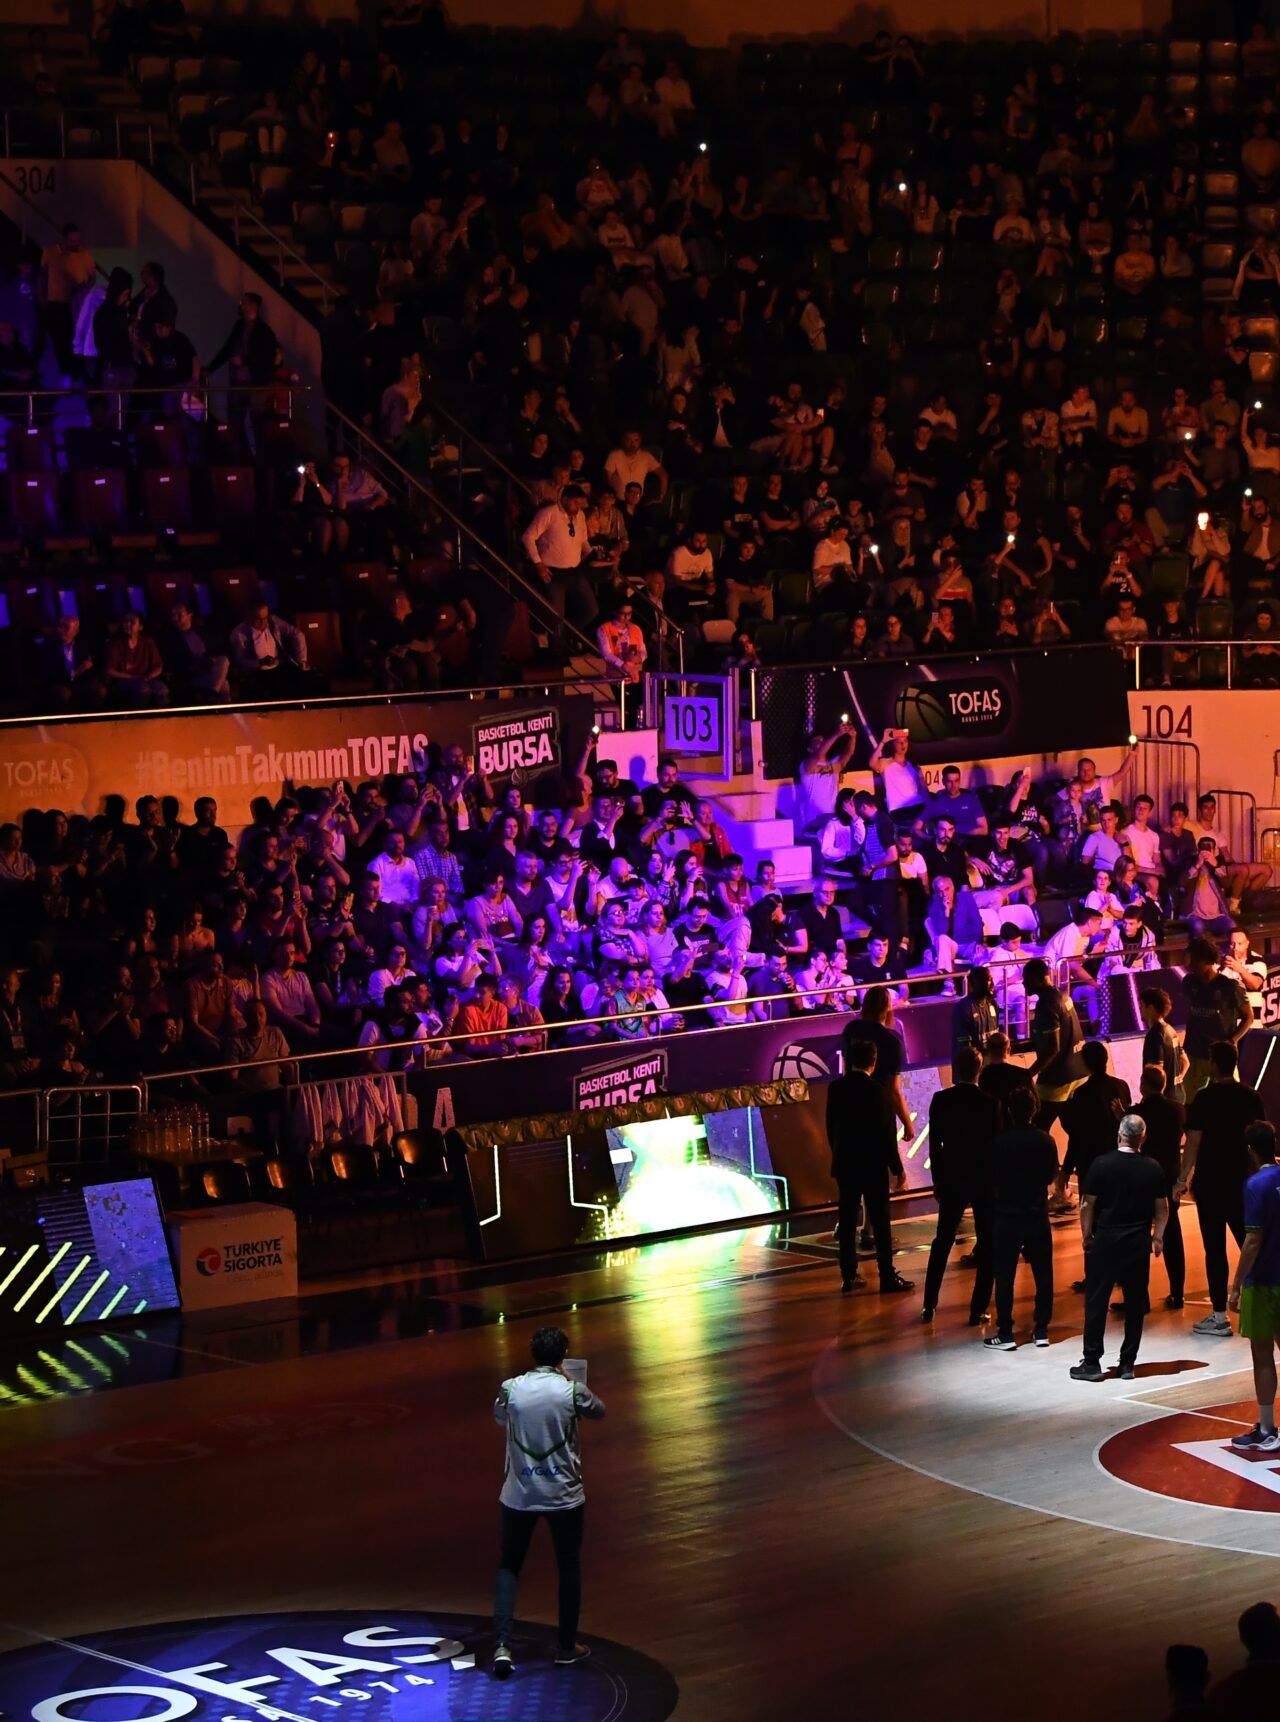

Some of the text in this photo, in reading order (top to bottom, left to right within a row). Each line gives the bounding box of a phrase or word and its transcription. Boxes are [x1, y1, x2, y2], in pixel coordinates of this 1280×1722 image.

[15, 166, 55, 194] 304
[948, 688, 1002, 717] TOFAŞ
[478, 721, 526, 743] BASKETBOL
[671, 704, 713, 742] 103
[1142, 704, 1192, 739] 104
[479, 733, 554, 776] BURSA
[579, 1068, 632, 1096] BASKETBOL
[30, 1625, 476, 1722] OFAŞ
[308, 1672, 436, 1709] 1974
